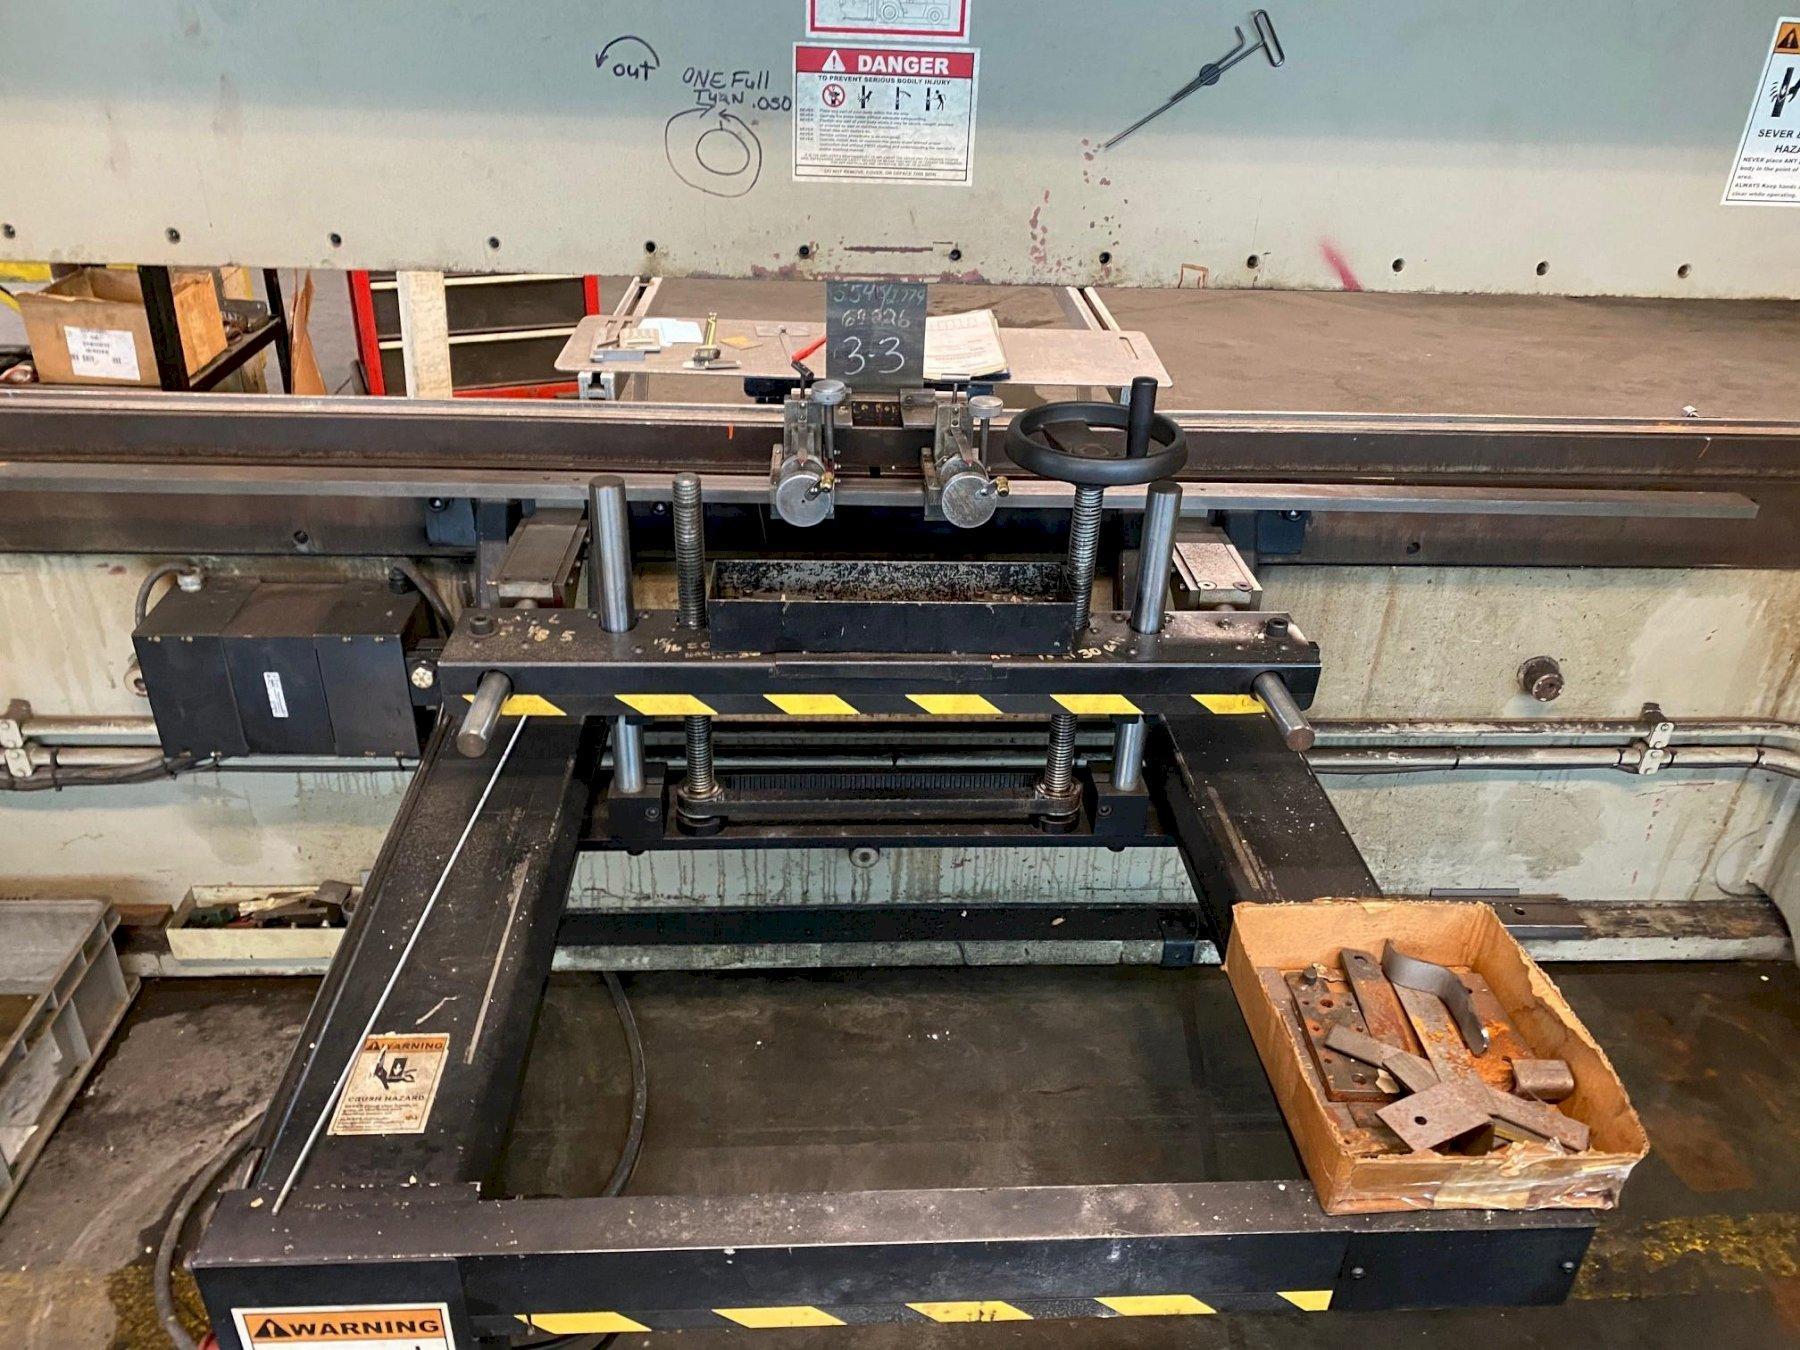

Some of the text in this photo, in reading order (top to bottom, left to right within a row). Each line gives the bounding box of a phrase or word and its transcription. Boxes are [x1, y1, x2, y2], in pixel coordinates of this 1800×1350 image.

[857, 54, 950, 75] DANGER
[682, 67, 727, 90] ONE
[1758, 129, 1794, 138] SEVER
[289, 1319, 440, 1336] WARNING
